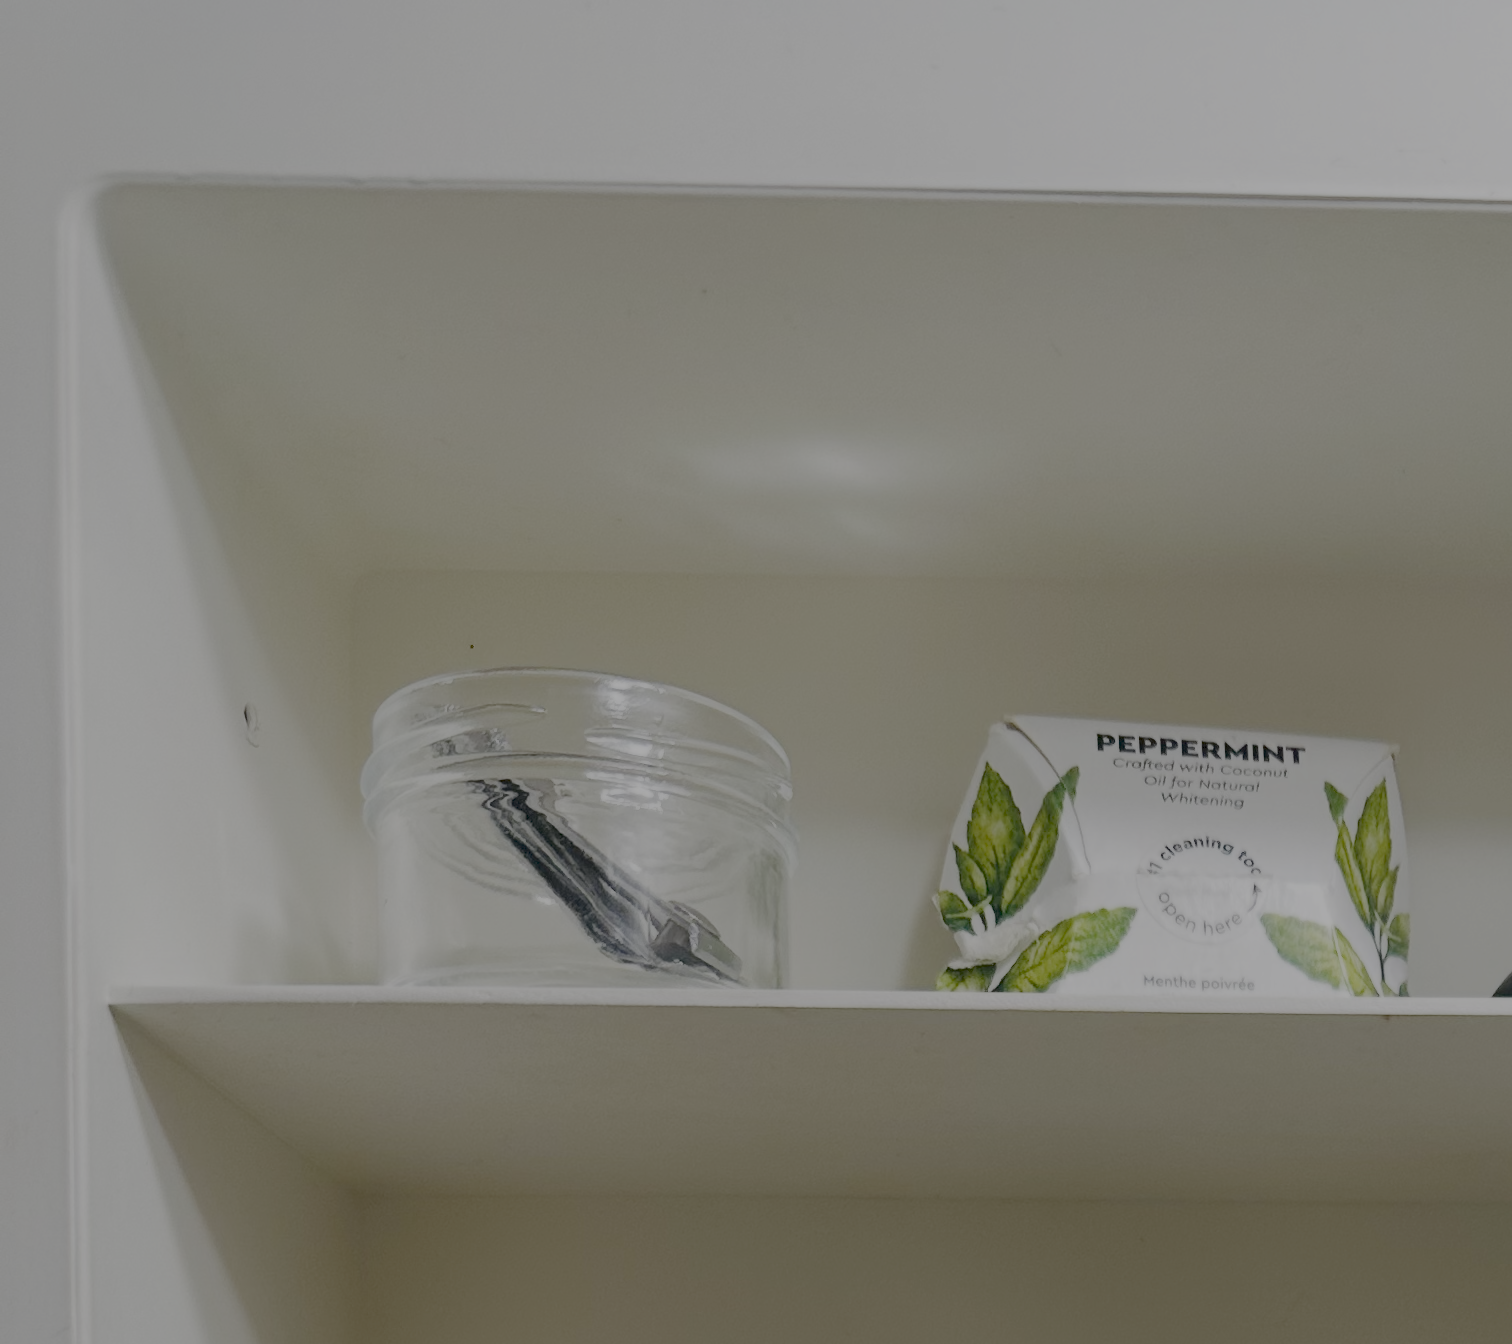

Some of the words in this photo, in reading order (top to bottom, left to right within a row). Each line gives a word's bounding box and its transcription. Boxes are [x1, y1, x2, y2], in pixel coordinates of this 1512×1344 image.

[1096, 733, 1306, 764] PEPPERMINT
[1113, 757, 1174, 773] Crafted
[1180, 762, 1214, 774] with
[1221, 765, 1288, 778] Coconut
[1144, 775, 1166, 786] Oil
[1170, 776, 1193, 790] for
[1200, 779, 1260, 793] Natural
[1161, 791, 1245, 810] Whitening
[1160, 836, 1235, 861] cleaning
[1158, 892, 1196, 933] open
[1203, 914, 1241, 936] here
[1143, 975, 1197, 989] Menthe
[1201, 976, 1255, 991] poivrée
